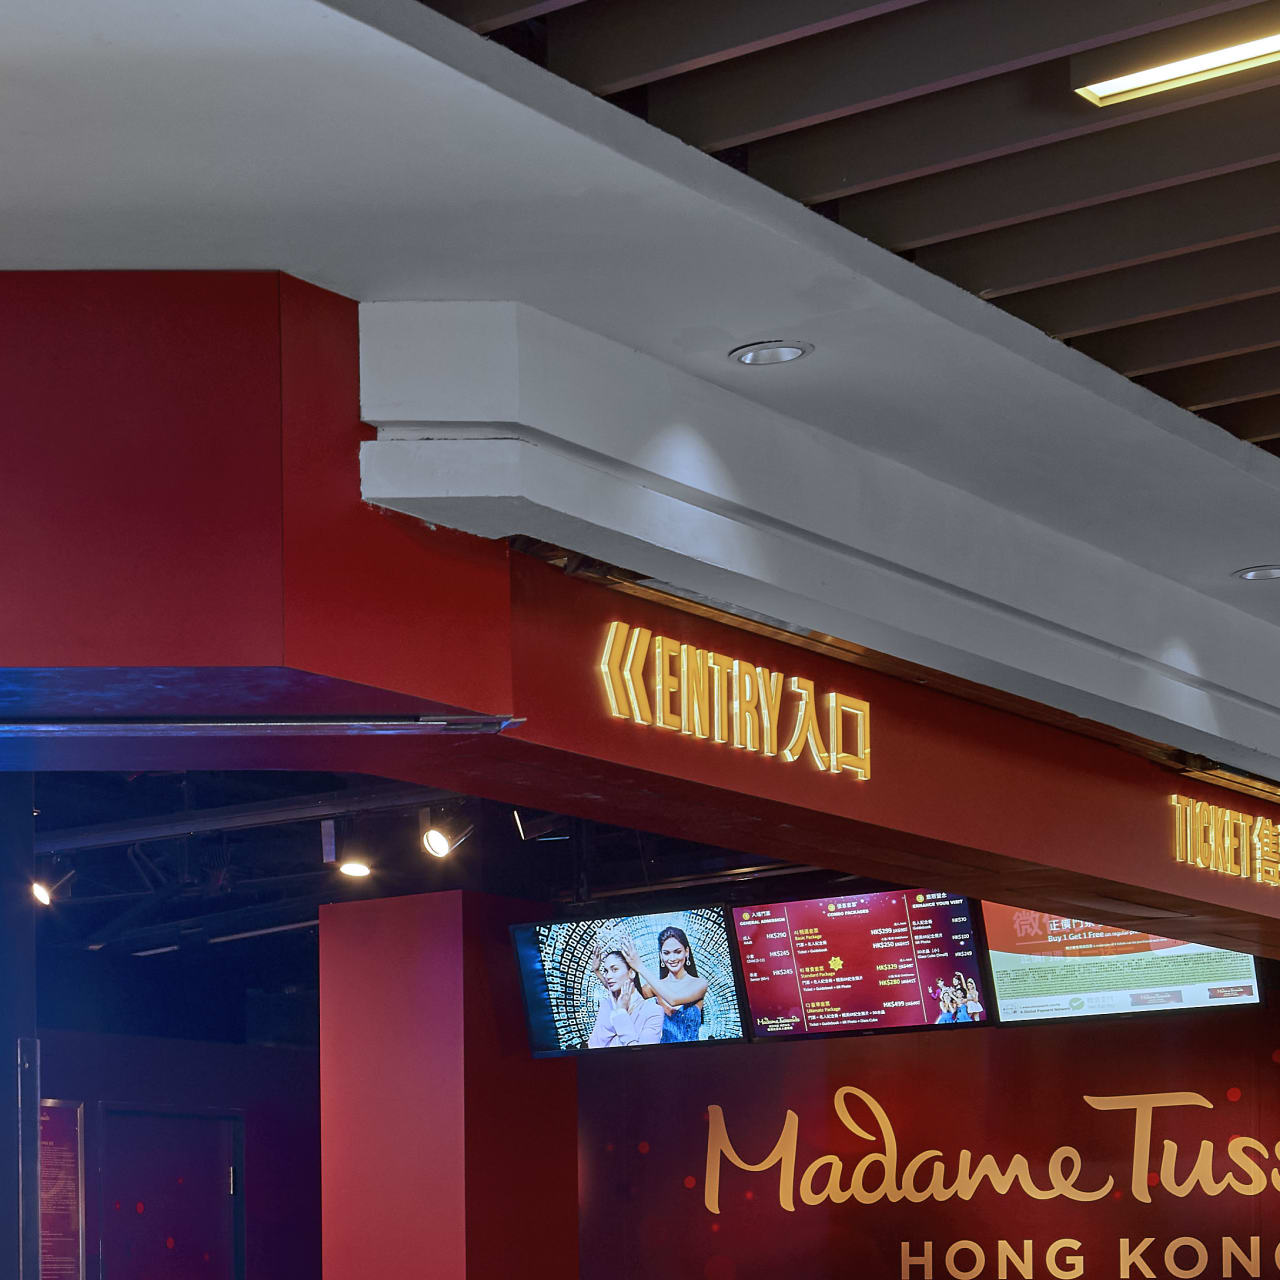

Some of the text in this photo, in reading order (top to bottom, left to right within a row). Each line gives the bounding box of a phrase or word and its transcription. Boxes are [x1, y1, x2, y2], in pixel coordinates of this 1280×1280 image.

[654, 635, 872, 782] ENTRY 入口
[1170, 794, 1254, 878] TICKET
[1047, 934, 1062, 943] Buy
[1069, 933, 1082, 941] Get
[1088, 931, 1104, 939] Free
[704, 1087, 1280, 1214] Madame Tus
[900, 1235, 1280, 1280] HONG KON
